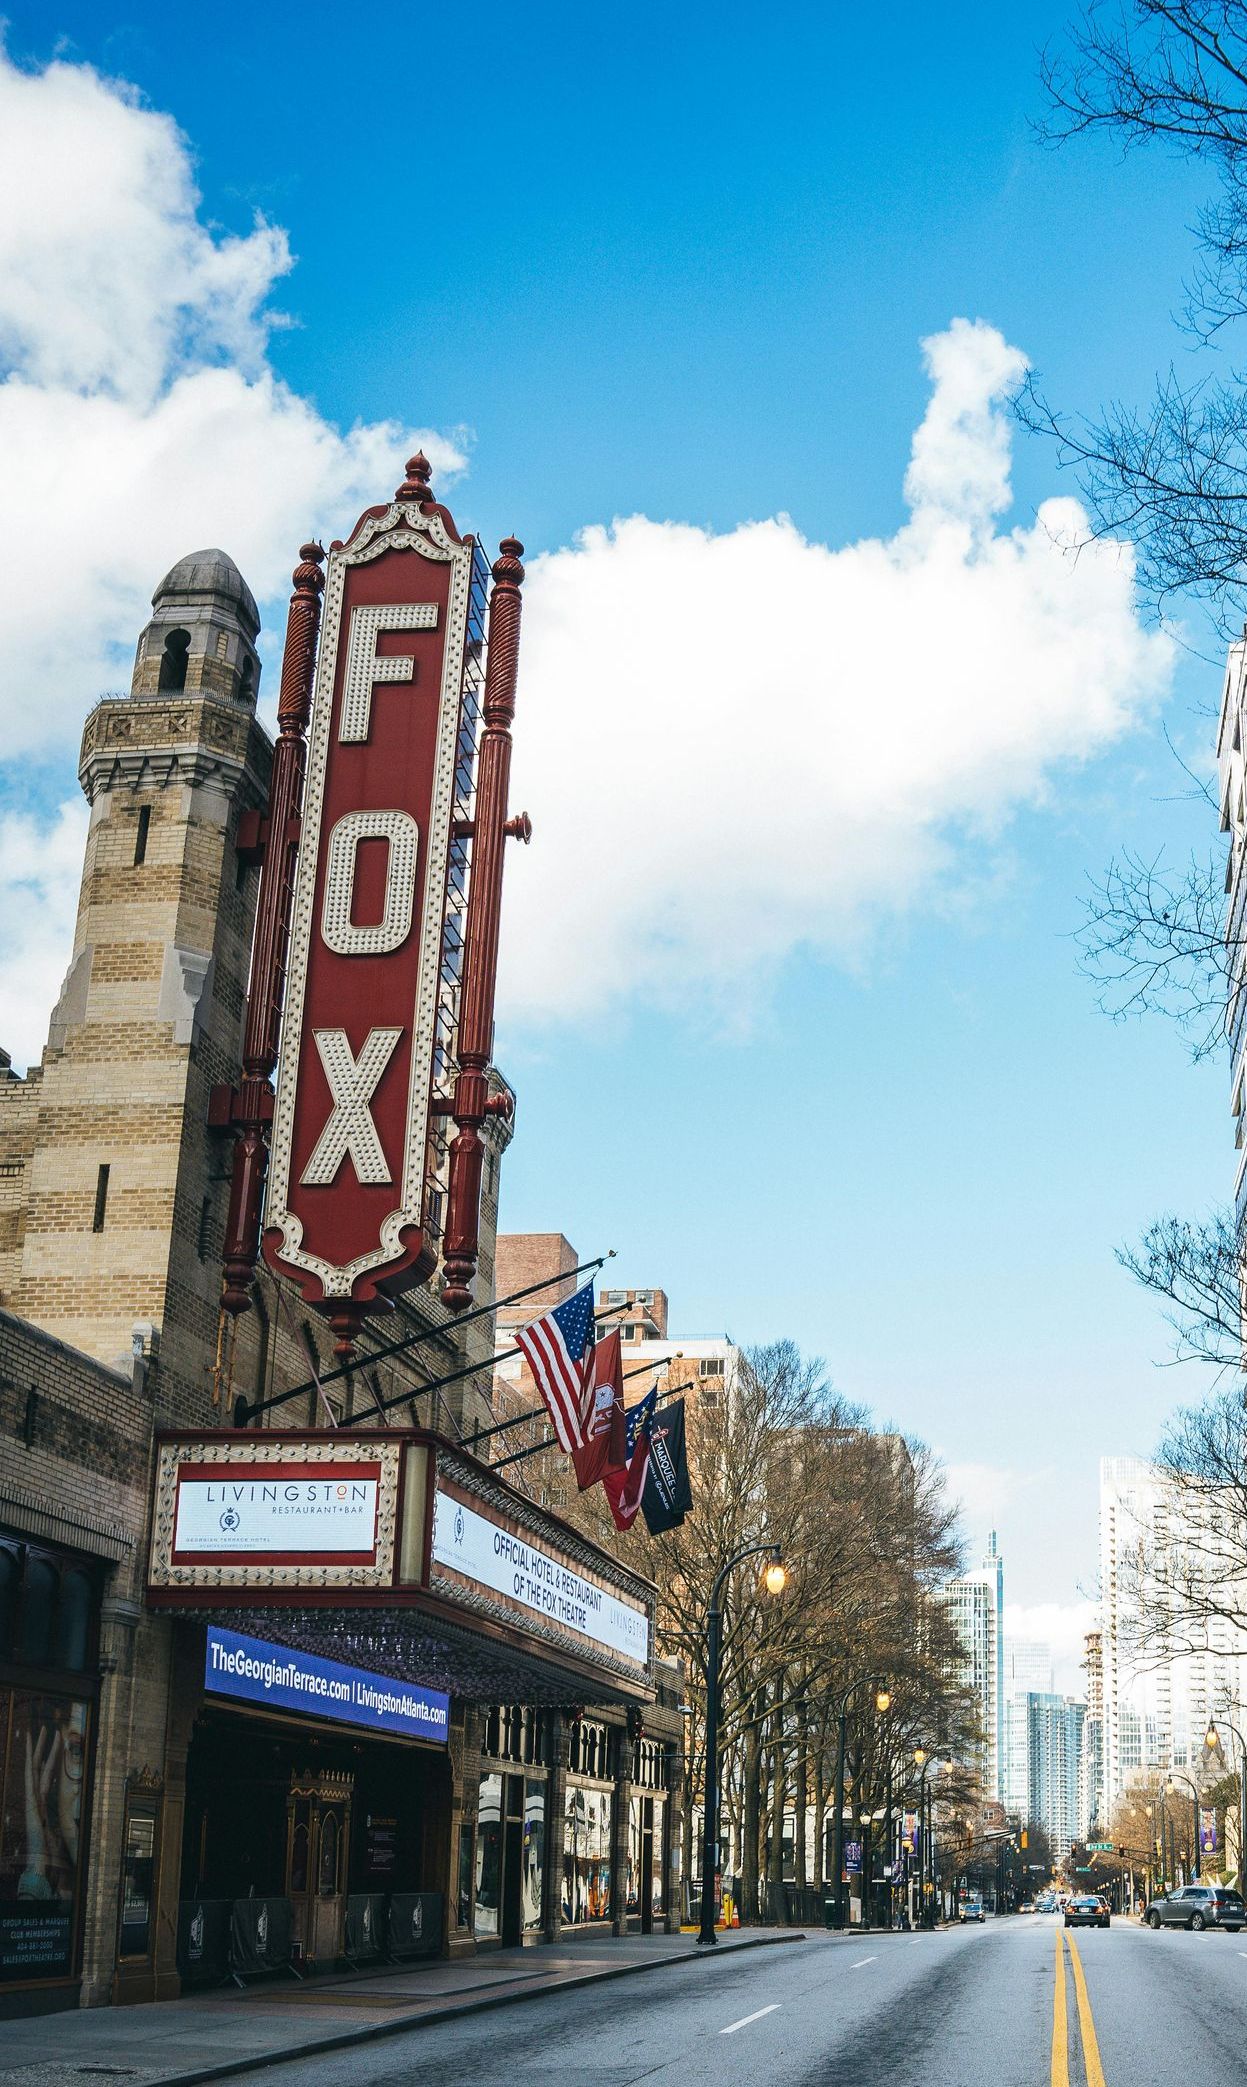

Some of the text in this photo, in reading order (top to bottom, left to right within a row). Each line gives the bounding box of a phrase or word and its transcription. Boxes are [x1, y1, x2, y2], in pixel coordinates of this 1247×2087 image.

[299, 603, 439, 1186] FOX
[655, 1442, 676, 1486] MARQUEE
[207, 1485, 367, 1502] LIVINGSTON
[493, 1532, 530, 1572] OFFICIAL
[532, 1554, 554, 1586] HOTEL
[555, 1569, 561, 1588] &
[561, 1572, 602, 1612] RESTAURANT
[513, 1573, 587, 1629] OF THE FOX THEATRE
[211, 1642, 350, 1702] TheGeorgianTerrace.com
[357, 1682, 446, 1725] LivingstonAtlanta.com
[2, 1919, 21, 1928] GROUP
[23, 1918, 38, 1926] SALES
[45, 1917, 70, 1925] MARQUEE
[10, 1929, 61, 1939] CLUB MEMBERSHIPS
